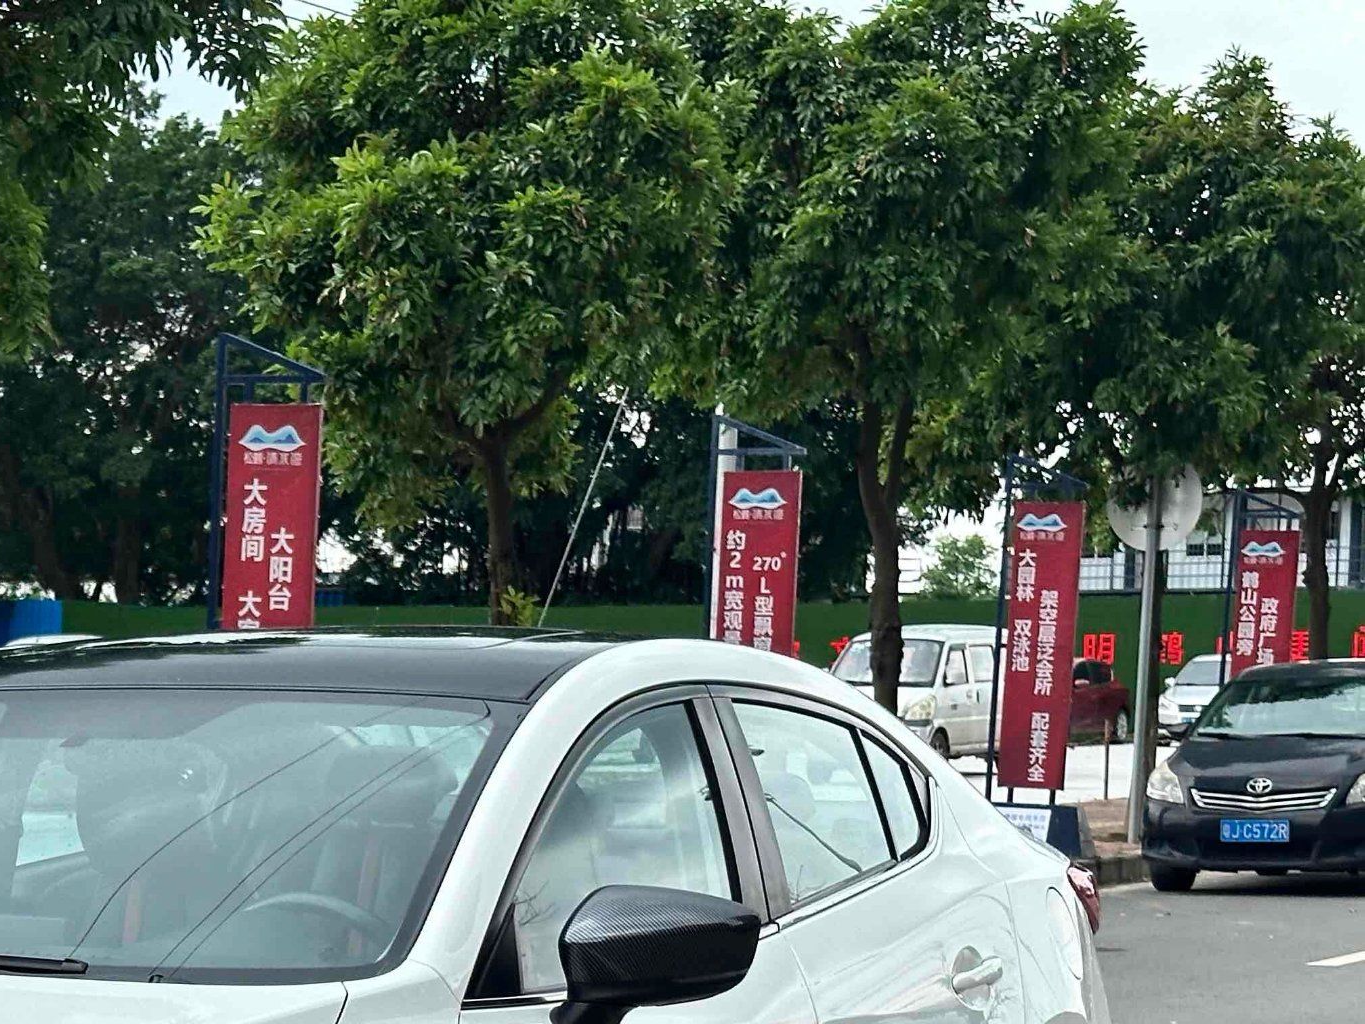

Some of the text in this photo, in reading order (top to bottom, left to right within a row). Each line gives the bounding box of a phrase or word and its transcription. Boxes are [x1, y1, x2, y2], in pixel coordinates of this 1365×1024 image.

[240, 478, 269, 563] 大房间
[267, 526, 295, 613] 大阳台
